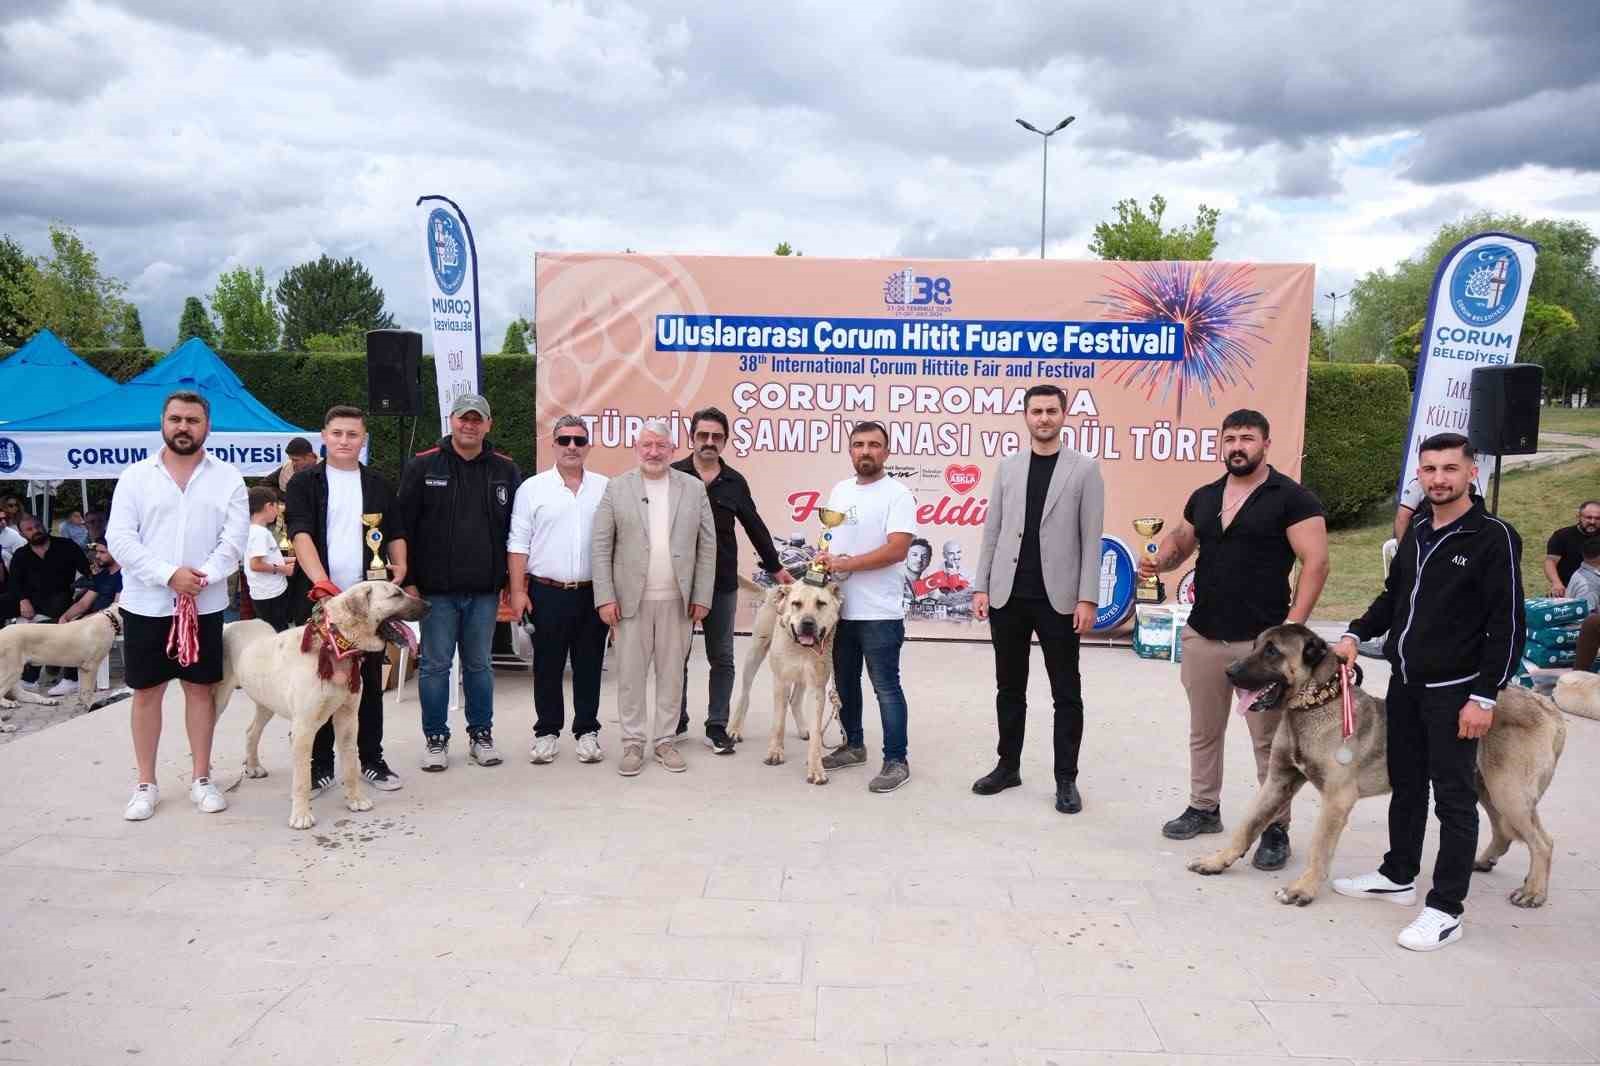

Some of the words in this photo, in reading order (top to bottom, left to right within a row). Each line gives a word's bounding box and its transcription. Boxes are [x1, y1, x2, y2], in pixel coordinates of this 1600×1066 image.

[911, 276, 953, 305] 38
[658, 318, 808, 348] Uluslararası
[814, 321, 896, 352] Çorum
[902, 323, 960, 350] Hitit
[965, 324, 1023, 352] Fuar
[1027, 331, 1058, 352] ve
[1064, 325, 1176, 354] Festivali
[1436, 326, 1513, 349] ÇORUM
[739, 355, 767, 372] 38th
[772, 355, 864, 374] International
[870, 358, 917, 378] Çorum
[922, 359, 968, 376] Hittite
[974, 359, 1001, 377] Fair
[1006, 361, 1032, 378] and
[1037, 361, 1095, 379] Festival
[1433, 347, 1509, 365] BELEDİYESİ
[732, 381, 875, 414] ÇORUM
[889, 385, 1099, 417] PROMAA
[1427, 405, 1471, 429] KÜLTÜ
[732, 414, 971, 457] ŞAMPİNASI
[981, 431, 1020, 457] ve
[1060, 419, 1121, 460] DÜL
[1130, 420, 1226, 462] TÖRE
[67, 447, 148, 469] ÇORUM
